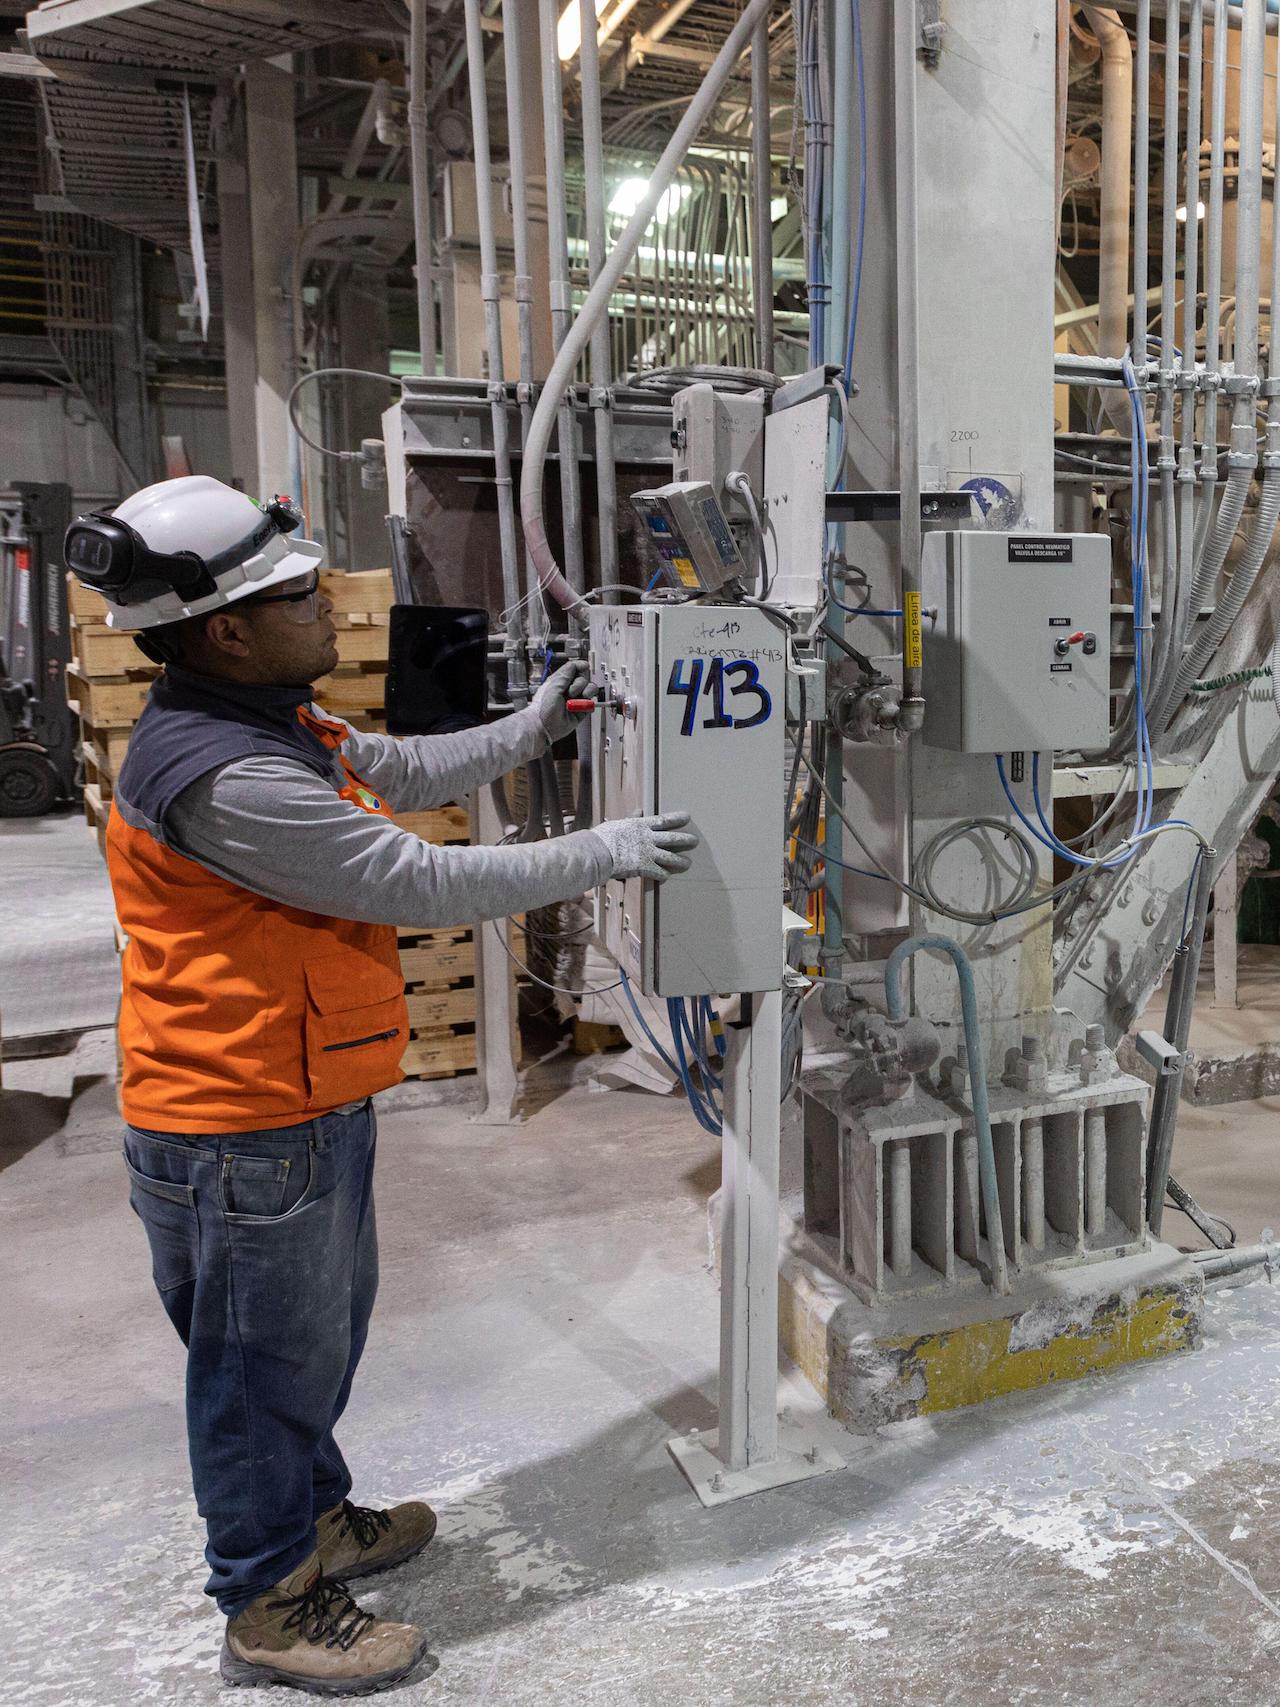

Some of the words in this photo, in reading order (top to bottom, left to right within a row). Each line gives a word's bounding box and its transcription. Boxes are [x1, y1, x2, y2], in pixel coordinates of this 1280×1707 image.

[911, 595, 920, 626] Linea
[912, 629, 920, 643] de
[666, 657, 772, 736] 413
